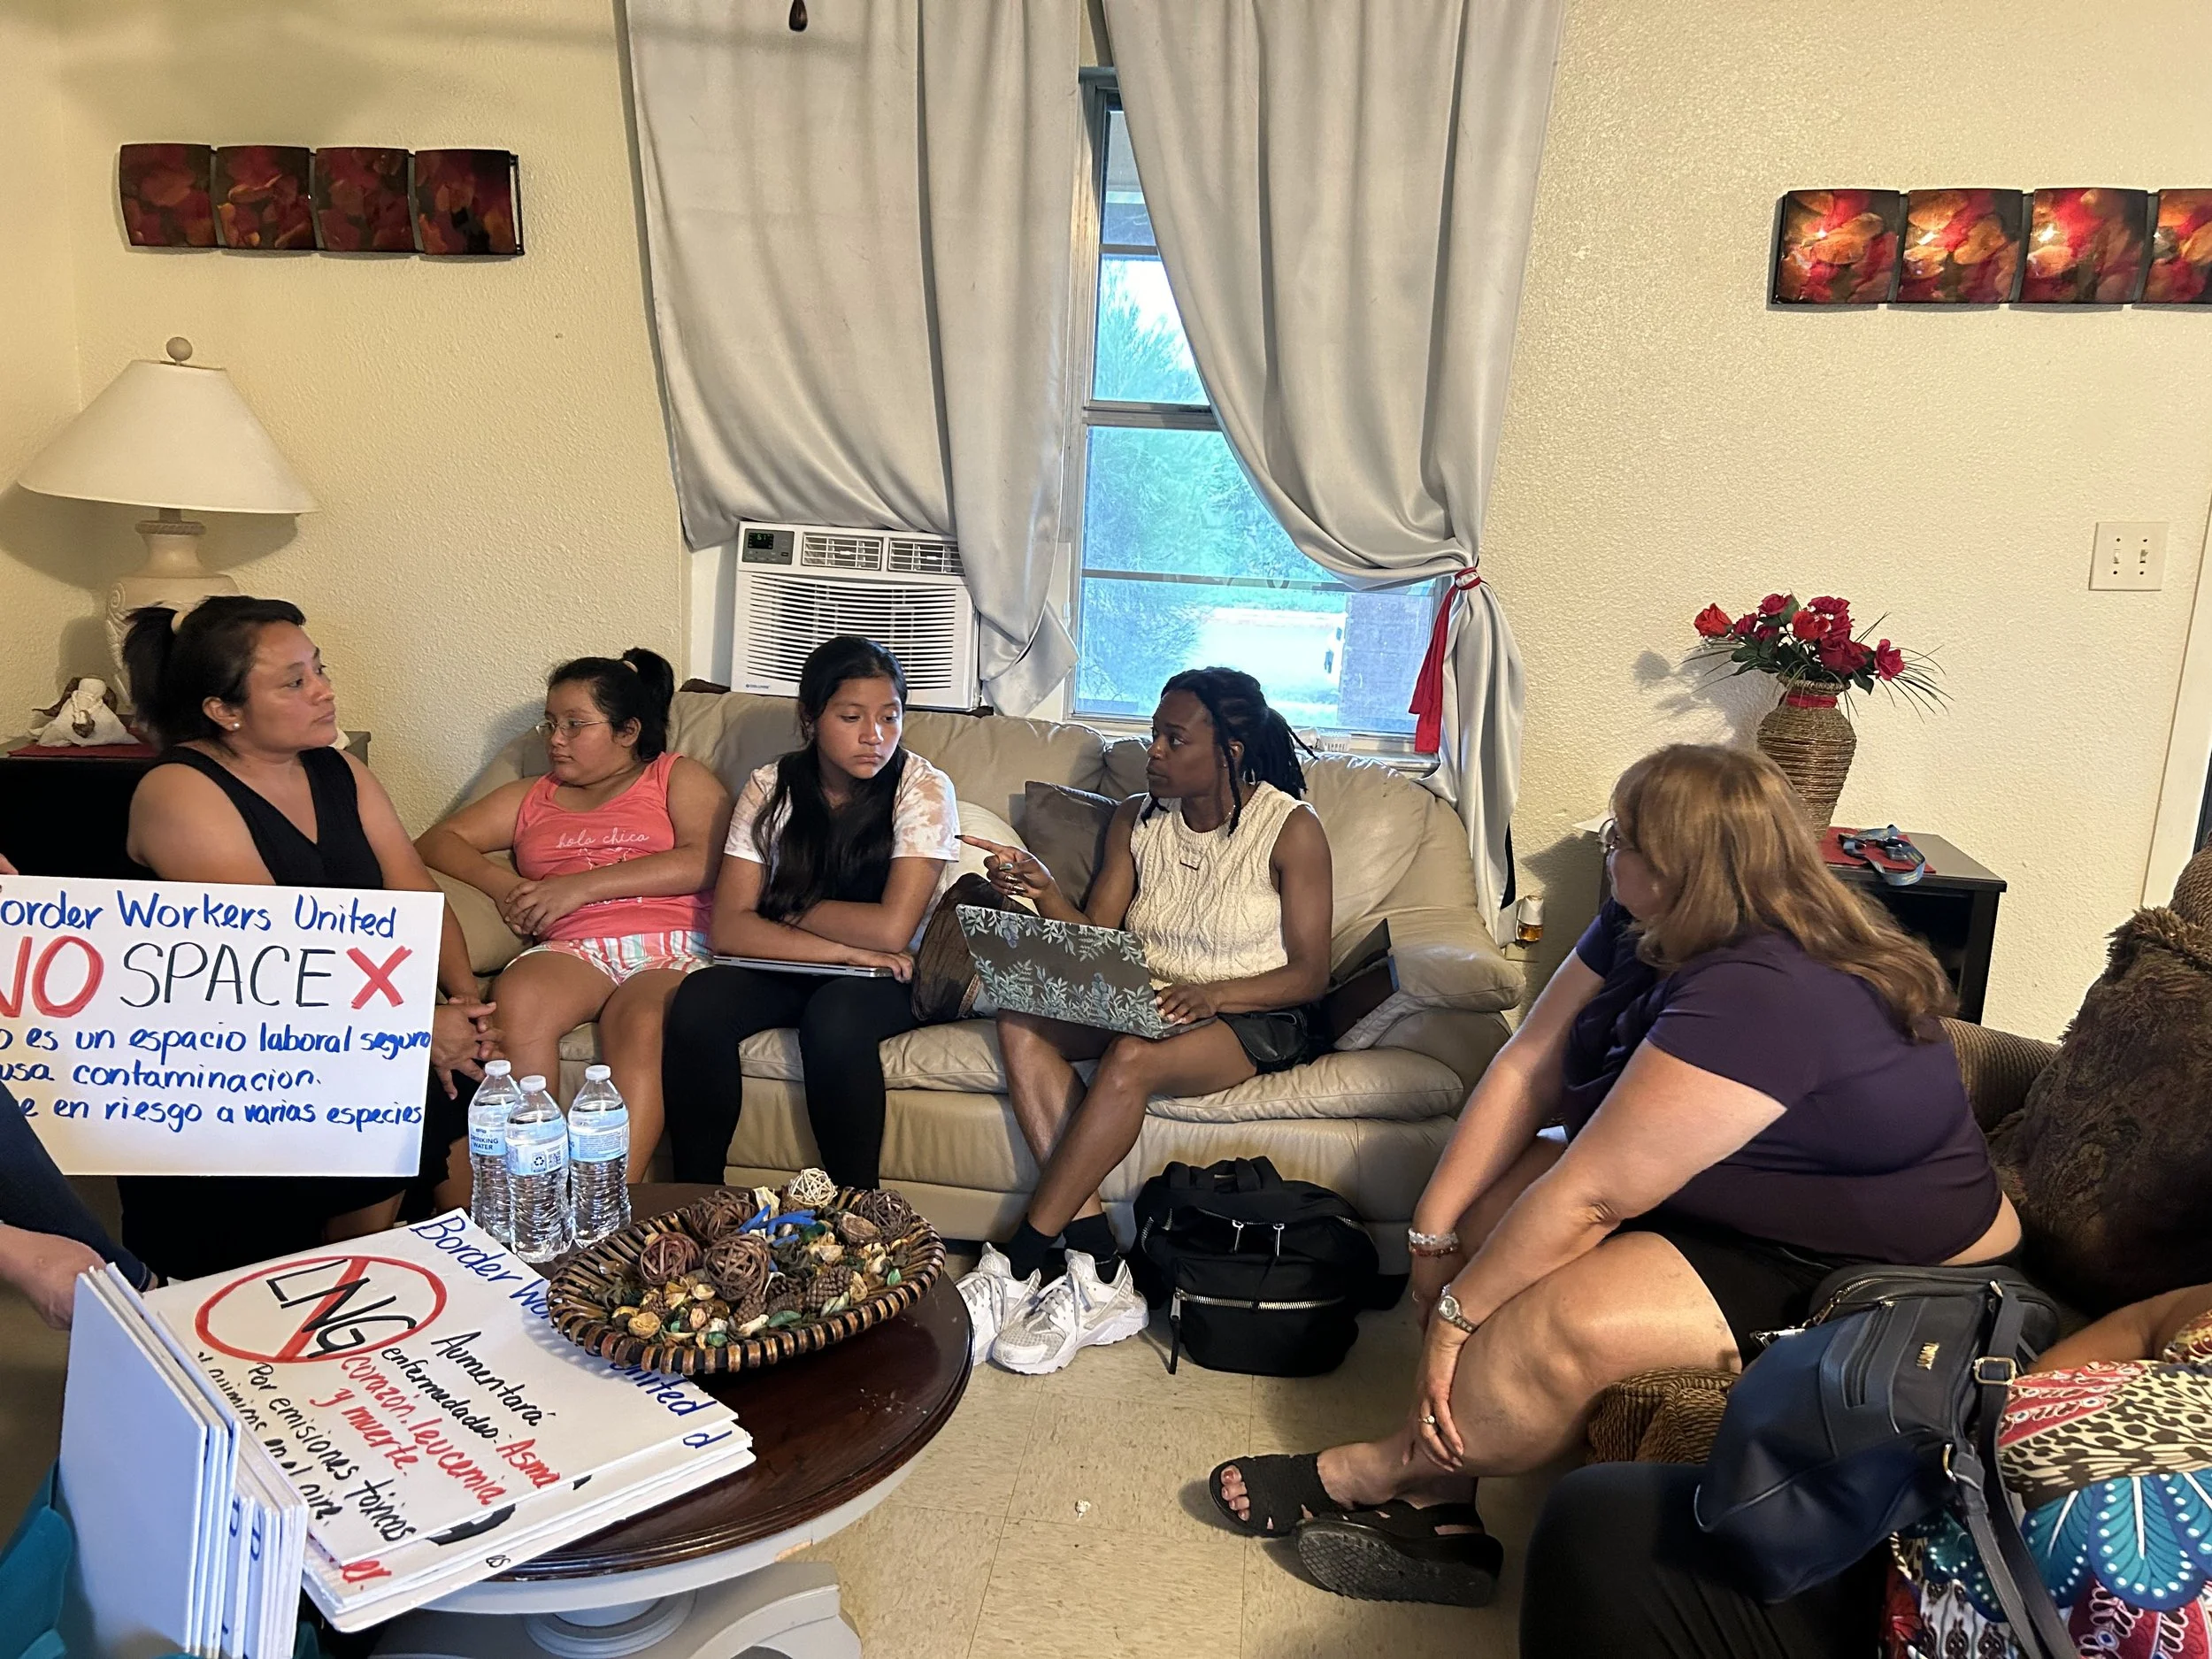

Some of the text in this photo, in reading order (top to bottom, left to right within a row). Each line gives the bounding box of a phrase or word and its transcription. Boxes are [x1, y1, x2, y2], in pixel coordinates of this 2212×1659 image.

[556, 827, 650, 849] hola chica
[117, 889, 272, 931] Workers
[295, 894, 396, 939] United
[26, 1027, 59, 1051] es
[75, 1029, 115, 1049] un
[129, 1022, 247, 1066] espacio
[259, 1022, 352, 1053] laboral
[360, 1031, 432, 1060] seguro
[73, 1059, 321, 1093] contaminacion.
[54, 1098, 88, 1118] en
[104, 1096, 203, 1133] riesgo
[217, 1105, 234, 1124] a
[244, 1100, 316, 1125] varias
[326, 1102, 422, 1133] especies
[408, 1215, 523, 1281] Border
[265, 1258, 418, 1359] LNG
[430, 1331, 557, 1427] Aumentará
[248, 1362, 277, 1392] Por
[269, 1396, 360, 1481] emisiones
[310, 1387, 419, 1477] y muerte.
[407, 1417, 507, 1505] leucemia
[495, 1438, 561, 1488] Asma
